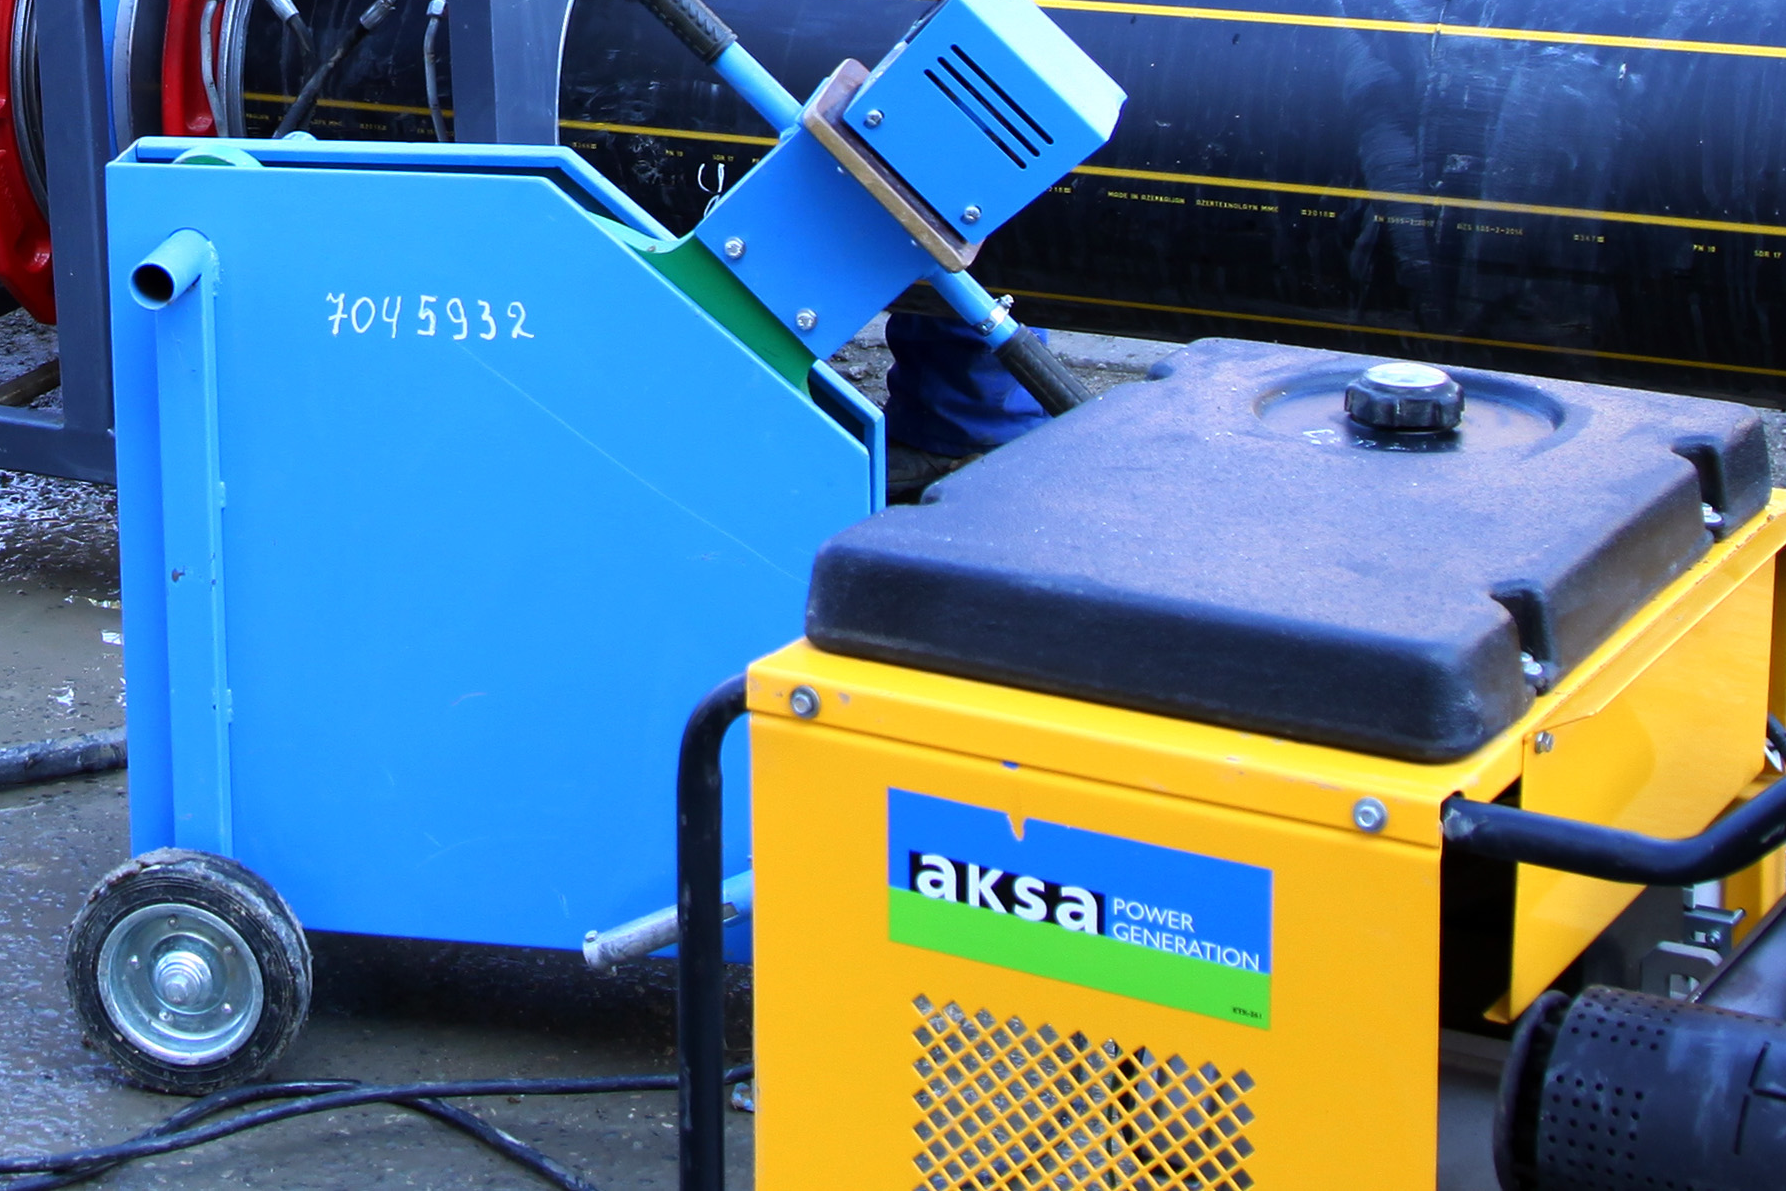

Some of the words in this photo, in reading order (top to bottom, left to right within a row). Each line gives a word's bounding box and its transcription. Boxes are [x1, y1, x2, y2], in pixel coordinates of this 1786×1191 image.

[1107, 191, 1128, 199] MADE
[1692, 243, 1705, 252] PN
[1754, 249, 1770, 258] SDR
[1773, 251, 1782, 259] 17
[915, 852, 1101, 936] aksa
[1113, 897, 1195, 933] POWER
[1112, 922, 1260, 972] GENERATION
